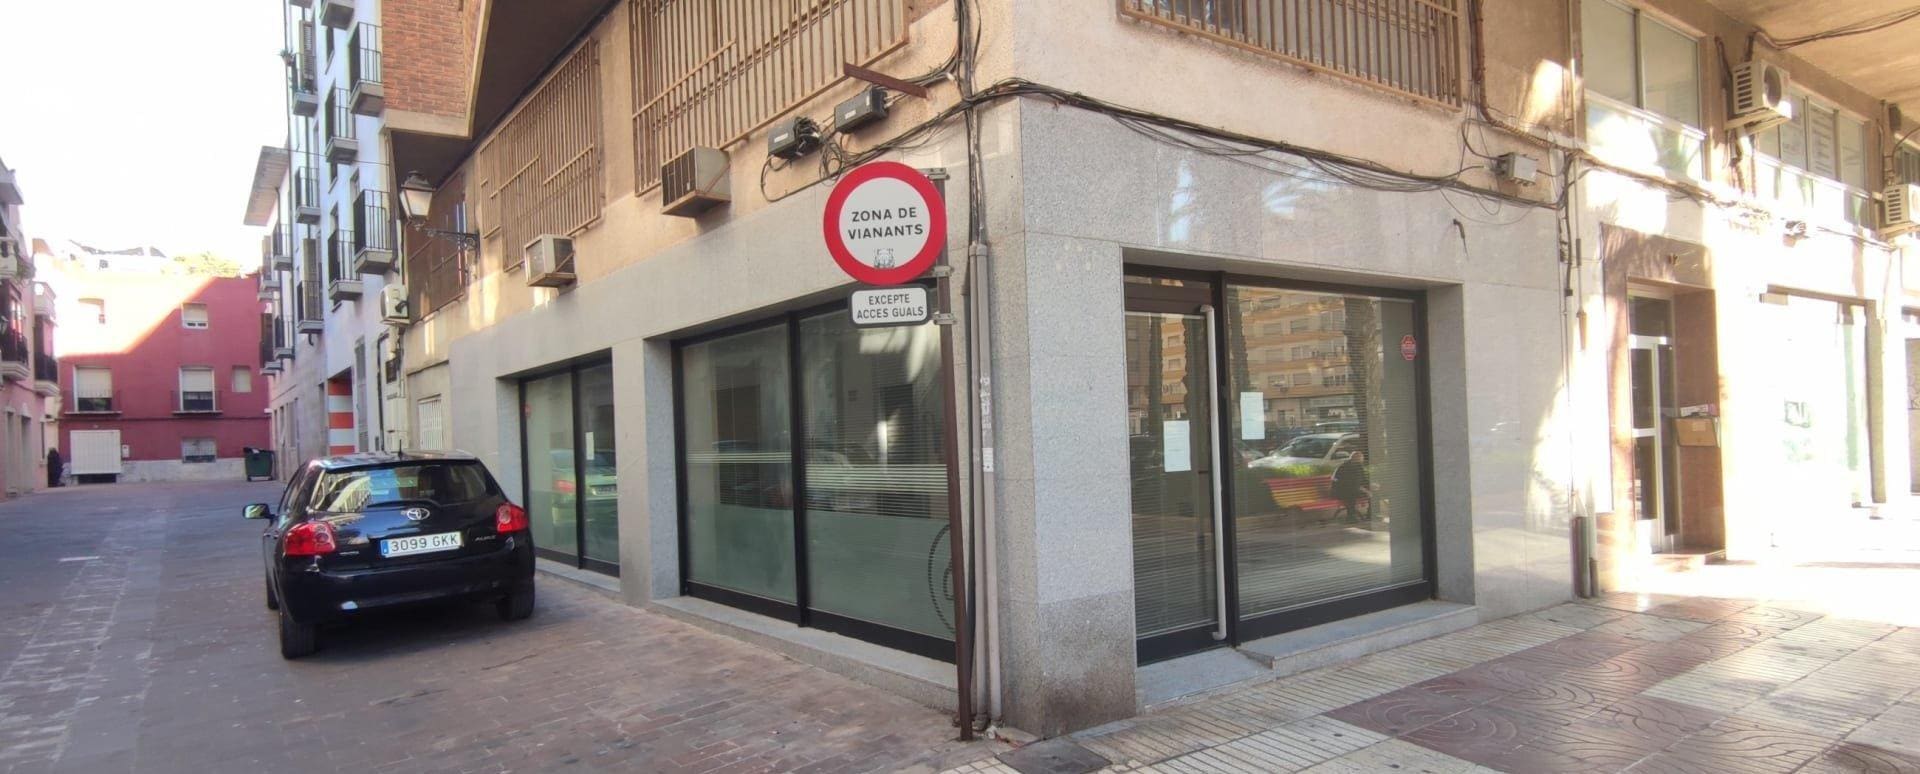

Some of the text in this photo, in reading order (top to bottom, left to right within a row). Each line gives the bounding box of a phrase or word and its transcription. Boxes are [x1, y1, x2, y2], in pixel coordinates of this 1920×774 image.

[851, 206, 917, 222] ZONA DE
[848, 224, 923, 240] VIANANTS
[868, 293, 911, 305] EXCEPTE
[856, 306, 924, 319] ACCES GUALS
[391, 534, 458, 552] 3099 GKK
